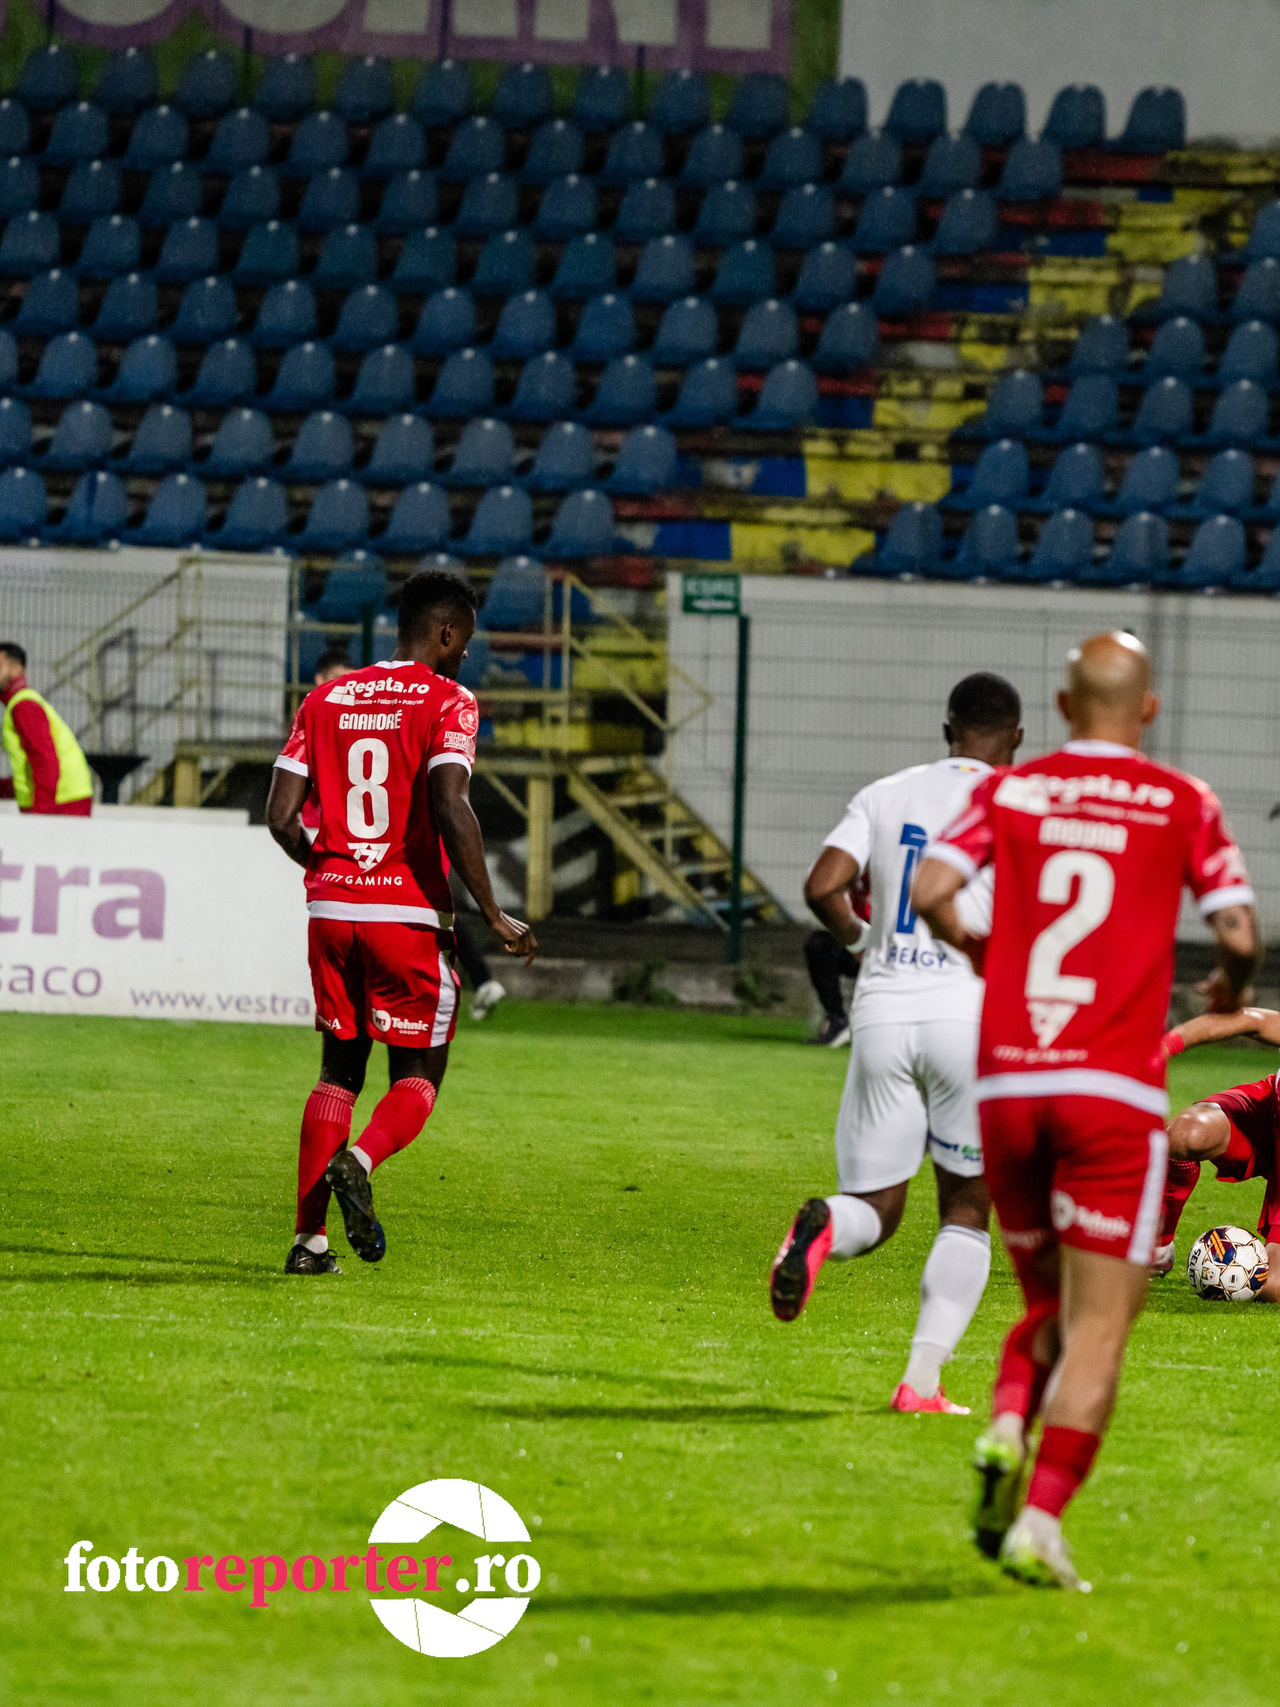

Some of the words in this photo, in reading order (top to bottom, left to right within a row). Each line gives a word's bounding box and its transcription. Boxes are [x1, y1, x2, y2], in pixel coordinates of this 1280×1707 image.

[345, 676, 430, 698] Regata.ro
[339, 709, 403, 731] GNAHORÉ
[346, 737, 390, 840] 8
[345, 875, 403, 886] GAMING
[1024, 849, 1116, 1006] 2
[0, 963, 103, 998] aco
[391, 1017, 429, 1031] Tehnic
